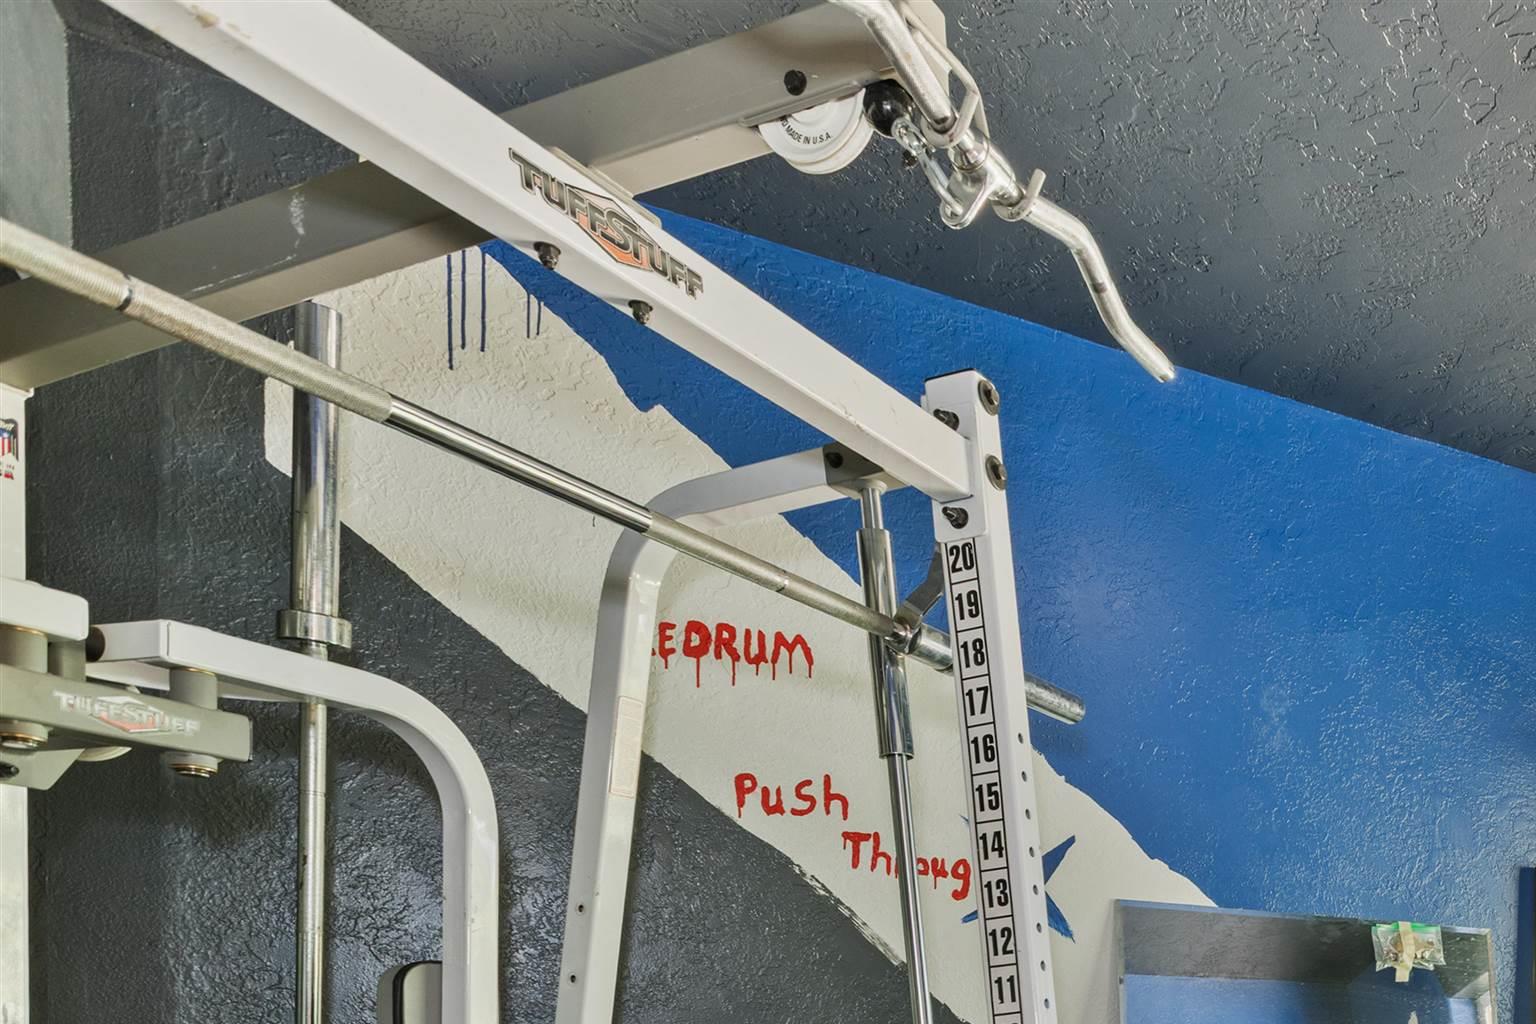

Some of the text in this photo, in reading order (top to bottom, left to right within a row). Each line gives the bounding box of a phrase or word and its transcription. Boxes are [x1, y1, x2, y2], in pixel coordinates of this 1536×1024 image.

[784, 125, 802, 143] MADE
[803, 136, 811, 145] IN
[508, 147, 704, 300] TUFFSTUFF
[949, 542, 975, 573] 20
[954, 589, 980, 621] 19
[652, 620, 814, 688] EDRUM
[960, 637, 986, 668] 18
[965, 685, 989, 716] 17
[970, 734, 996, 764] 16
[734, 773, 849, 821] Push
[975, 781, 1000, 812] 15
[979, 830, 1004, 860] 14
[984, 878, 1009, 908] 13
[988, 926, 1014, 957] 12
[994, 975, 1016, 1005] 11
